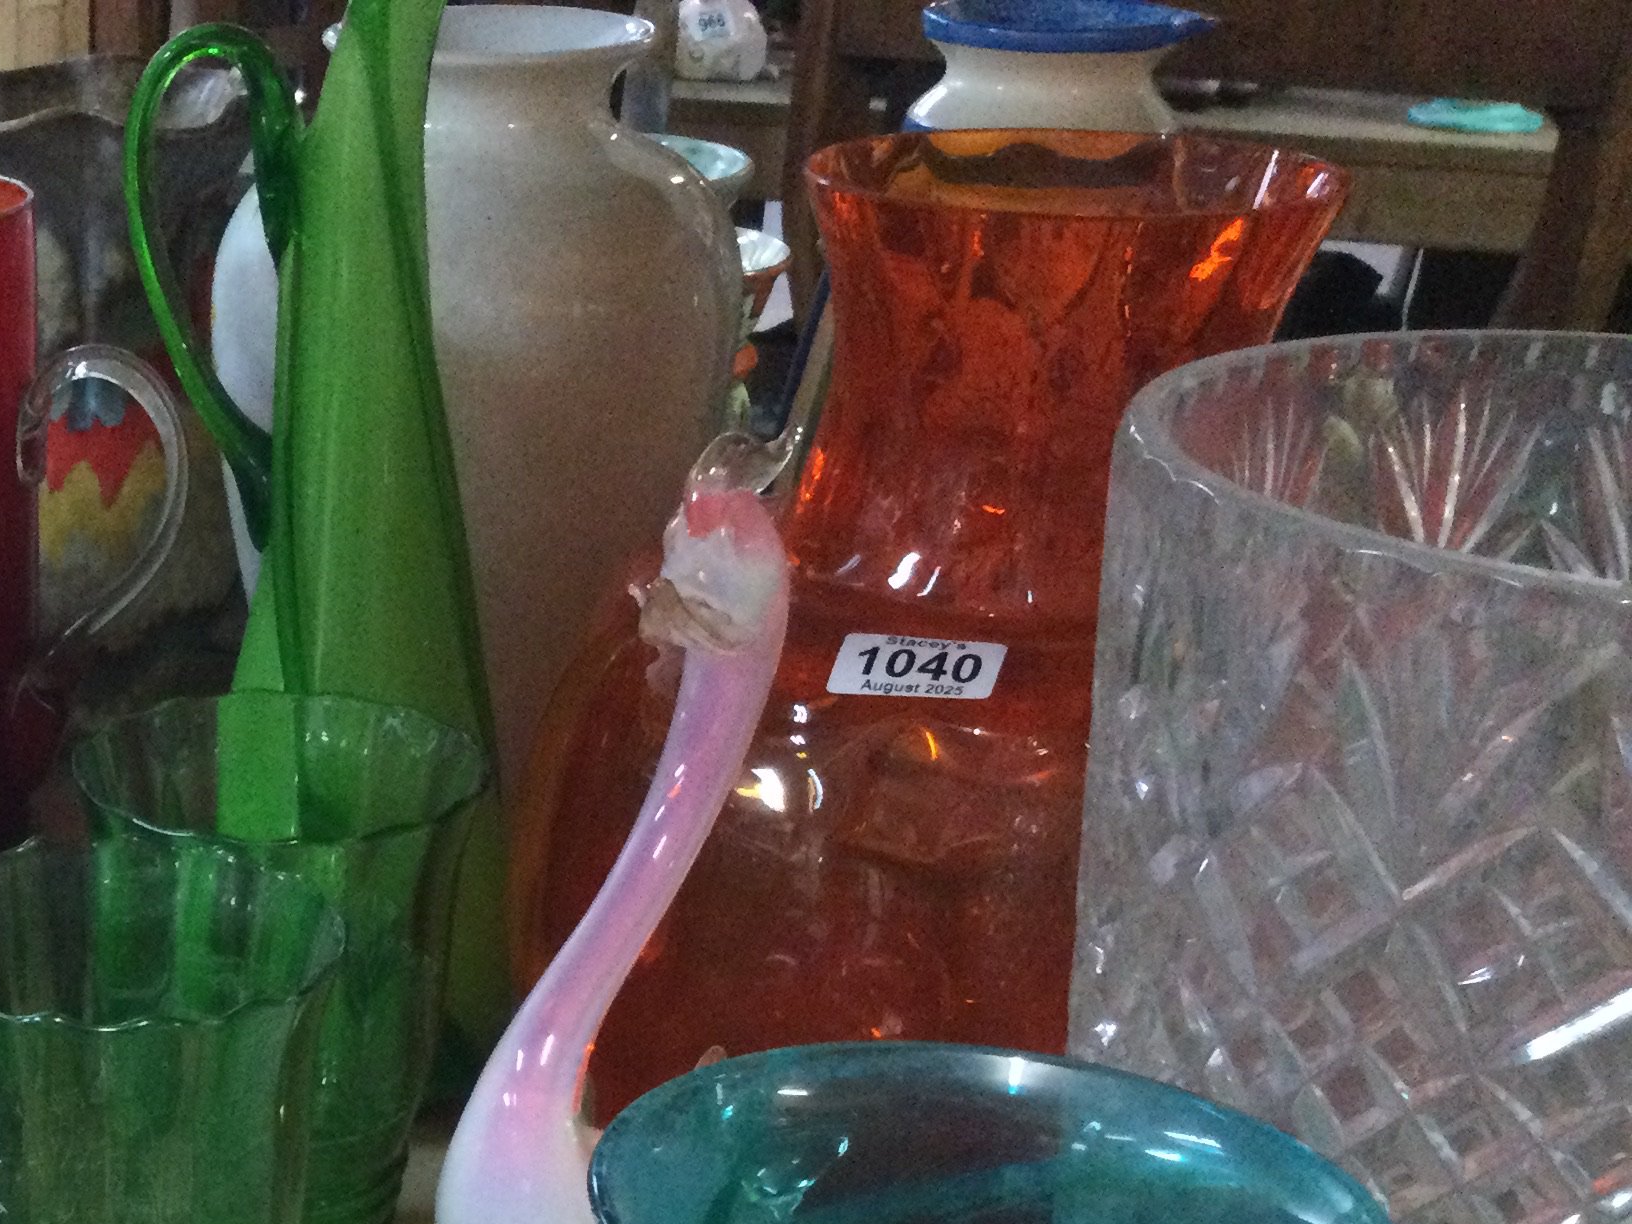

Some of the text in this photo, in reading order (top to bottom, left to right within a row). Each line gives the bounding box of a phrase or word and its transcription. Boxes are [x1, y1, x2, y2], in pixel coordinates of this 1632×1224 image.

[886, 636, 966, 651] Stacey's
[858, 646, 983, 684] 1040
[860, 679, 965, 696] August 2025
